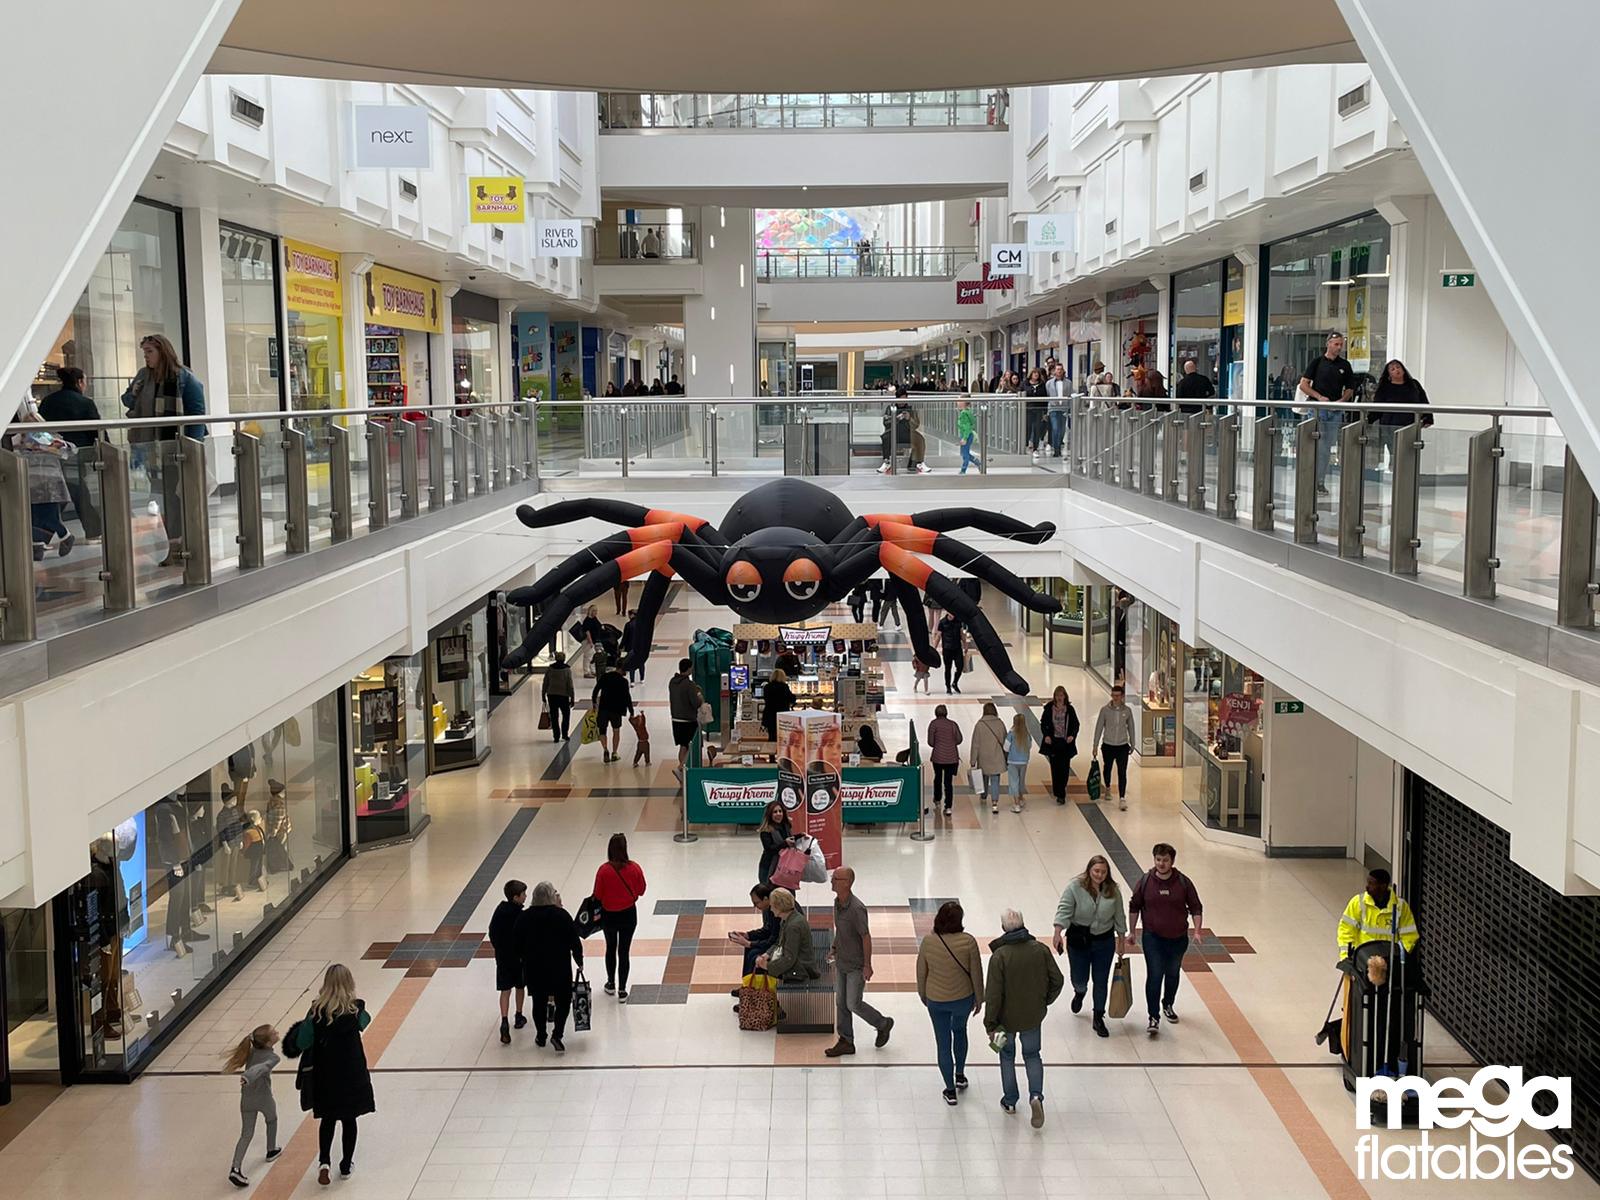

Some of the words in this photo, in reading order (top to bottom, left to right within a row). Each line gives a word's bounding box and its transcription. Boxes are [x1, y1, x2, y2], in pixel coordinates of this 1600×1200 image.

[371, 129, 414, 144] next
[476, 204, 518, 212] BARNHAUS
[545, 228, 574, 238] RIVER
[541, 238, 578, 249] ISLAND
[997, 250, 1022, 263] CM
[292, 250, 304, 272] TOY
[303, 254, 334, 280] BARNHAUS
[960, 287, 980, 298] bm
[382, 283, 396, 311] TOY
[395, 286, 425, 317] BARNHAUS
[1226, 698, 1251, 710] KENJI
[709, 787, 743, 801] Krispy
[743, 787, 775, 799] Kreme
[841, 787, 865, 800] rispy
[865, 786, 898, 799] Kreme
